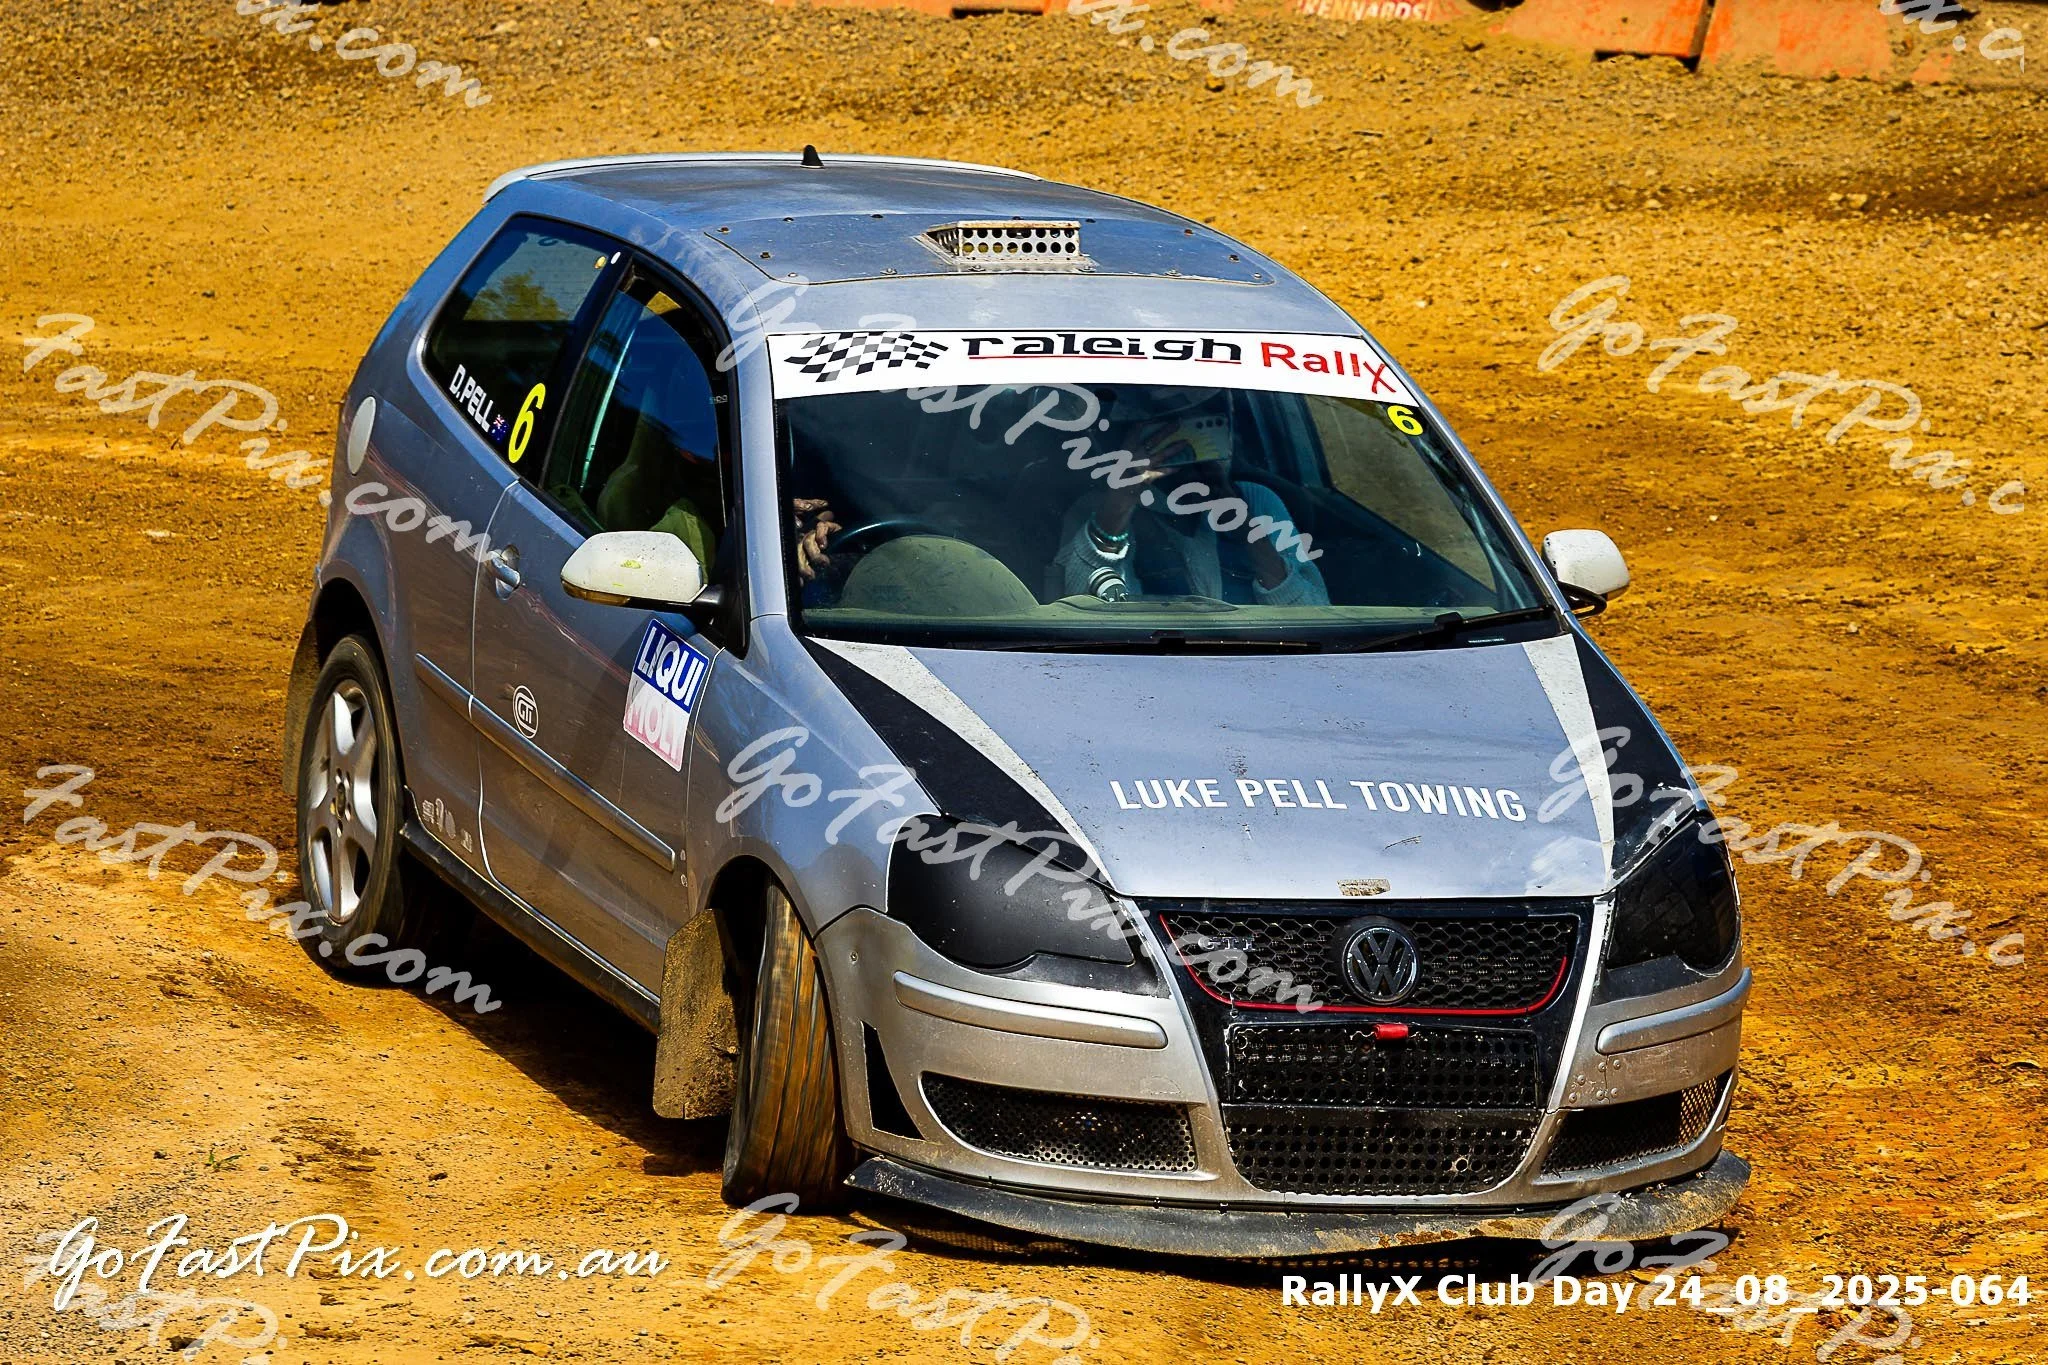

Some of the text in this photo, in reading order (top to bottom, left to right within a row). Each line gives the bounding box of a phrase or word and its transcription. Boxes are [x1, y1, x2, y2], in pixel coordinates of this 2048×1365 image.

[961, 333, 1242, 364] raleigh
[449, 363, 494, 433] D.PELL
[508, 382, 546, 464] 6
[1386, 404, 1424, 437] 6
[637, 626, 705, 706] LIQUI
[1110, 778, 1527, 822] LUKE PELL TOWING
